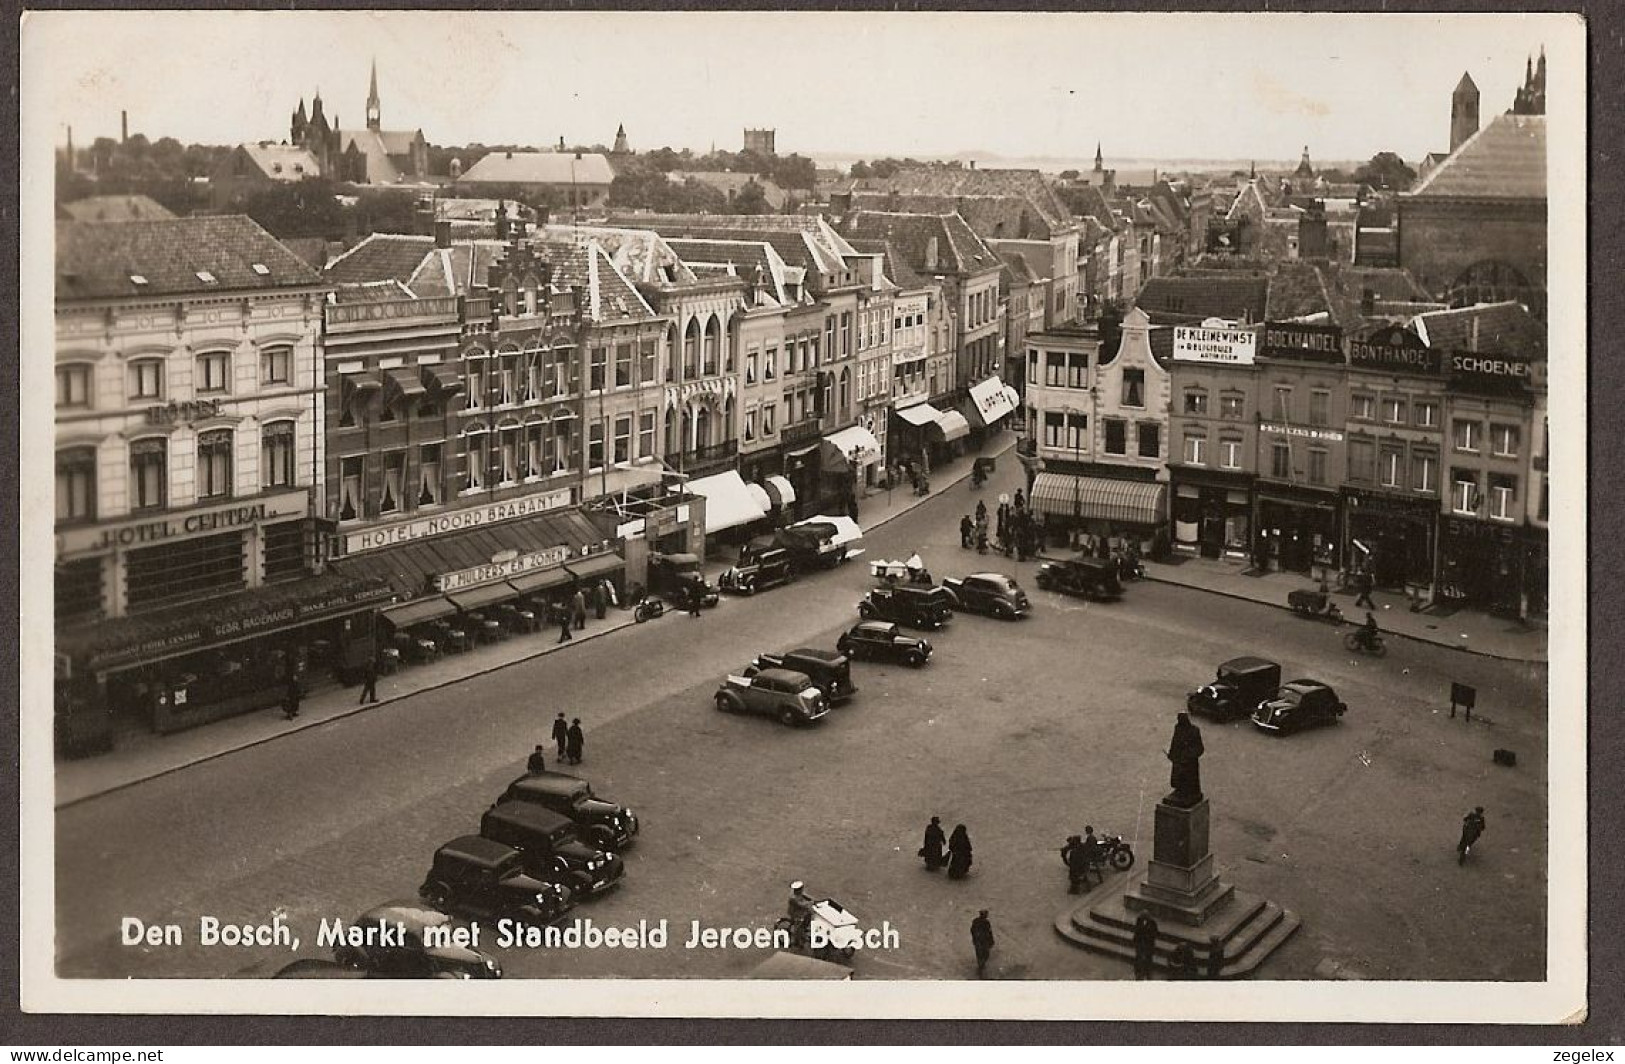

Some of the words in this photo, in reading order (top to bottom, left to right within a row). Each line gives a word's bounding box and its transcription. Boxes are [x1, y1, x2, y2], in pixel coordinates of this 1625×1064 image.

[1176, 328, 1186, 340] DE
[1267, 329, 1338, 352] BOEKHANDEL
[1352, 343, 1432, 365] BONTHANDEL
[1453, 356, 1532, 377] SCHOENEN
[184, 503, 266, 533] CENTRAL
[362, 528, 418, 548] HOTEL
[458, 565, 505, 586] MULDERS
[510, 559, 525, 572] EN
[530, 549, 562, 567] ZONEN
